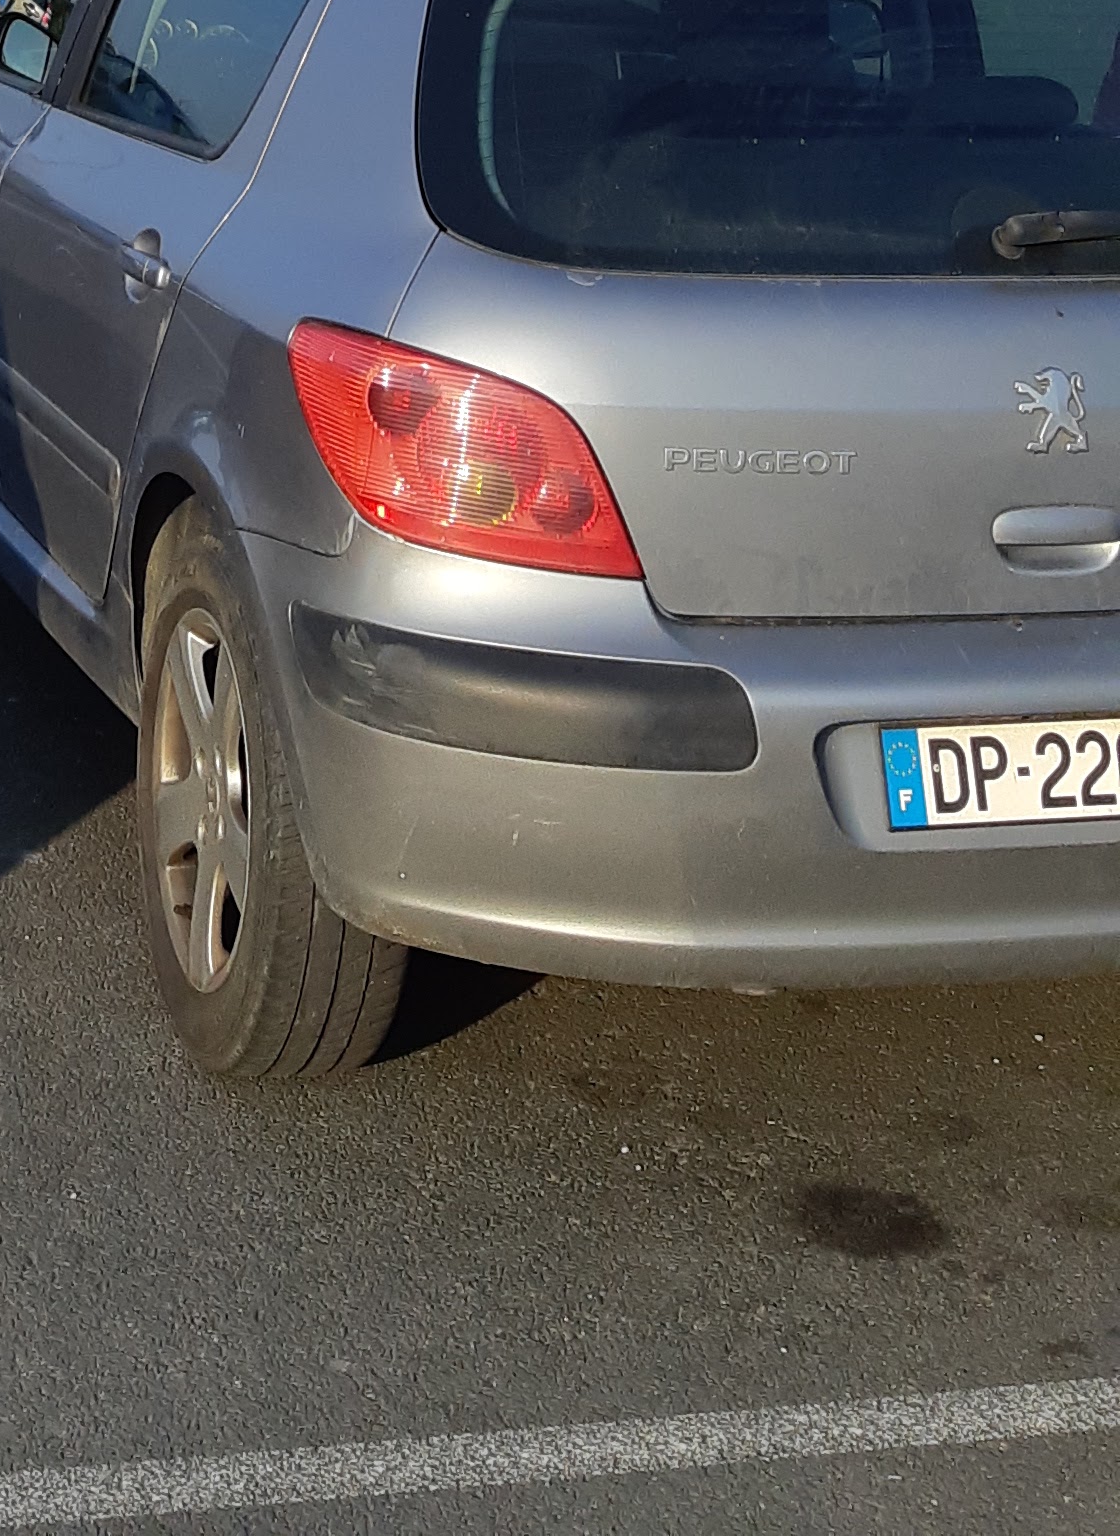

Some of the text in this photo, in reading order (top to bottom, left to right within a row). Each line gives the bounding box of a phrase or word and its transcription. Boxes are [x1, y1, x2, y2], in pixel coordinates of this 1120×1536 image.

[663, 447, 858, 475] PEUGEOT
[928, 730, 1120, 814] DP-22
[898, 789, 913, 812] F
